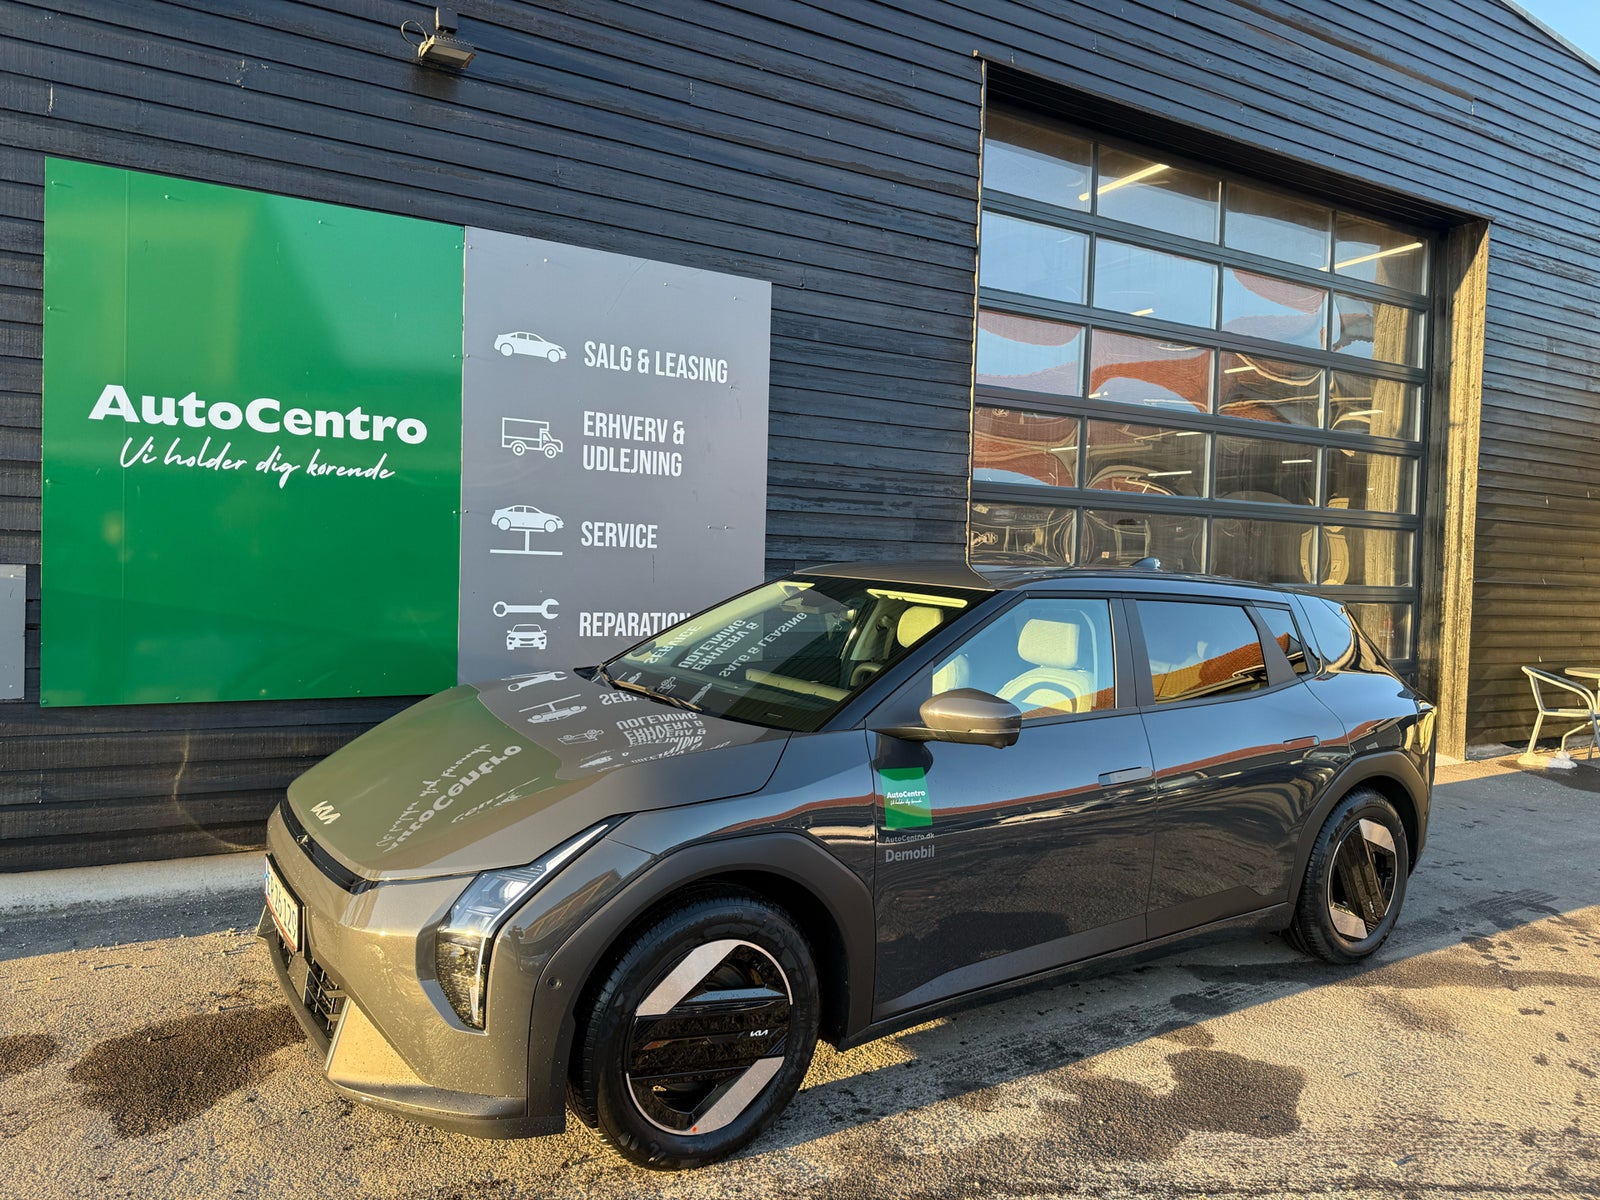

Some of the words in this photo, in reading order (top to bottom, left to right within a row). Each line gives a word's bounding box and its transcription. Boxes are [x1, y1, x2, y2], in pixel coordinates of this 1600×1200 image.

[584, 340, 632, 372] SALG
[637, 349, 650, 374] &
[655, 351, 728, 384] LEASING
[88, 384, 428, 445] AutoCentro
[583, 410, 668, 444] ERHVERV
[672, 421, 685, 445] &
[120, 436, 157, 468] Vi
[163, 436, 248, 471] holder
[256, 445, 301, 489] dig
[306, 448, 396, 480] kørende
[582, 445, 682, 477] UDLEJNING
[580, 520, 658, 549] SERVICE
[887, 790, 926, 799] AutoCentro
[885, 832, 935, 843] AutoCentro.dk
[885, 845, 935, 863] Demobil
